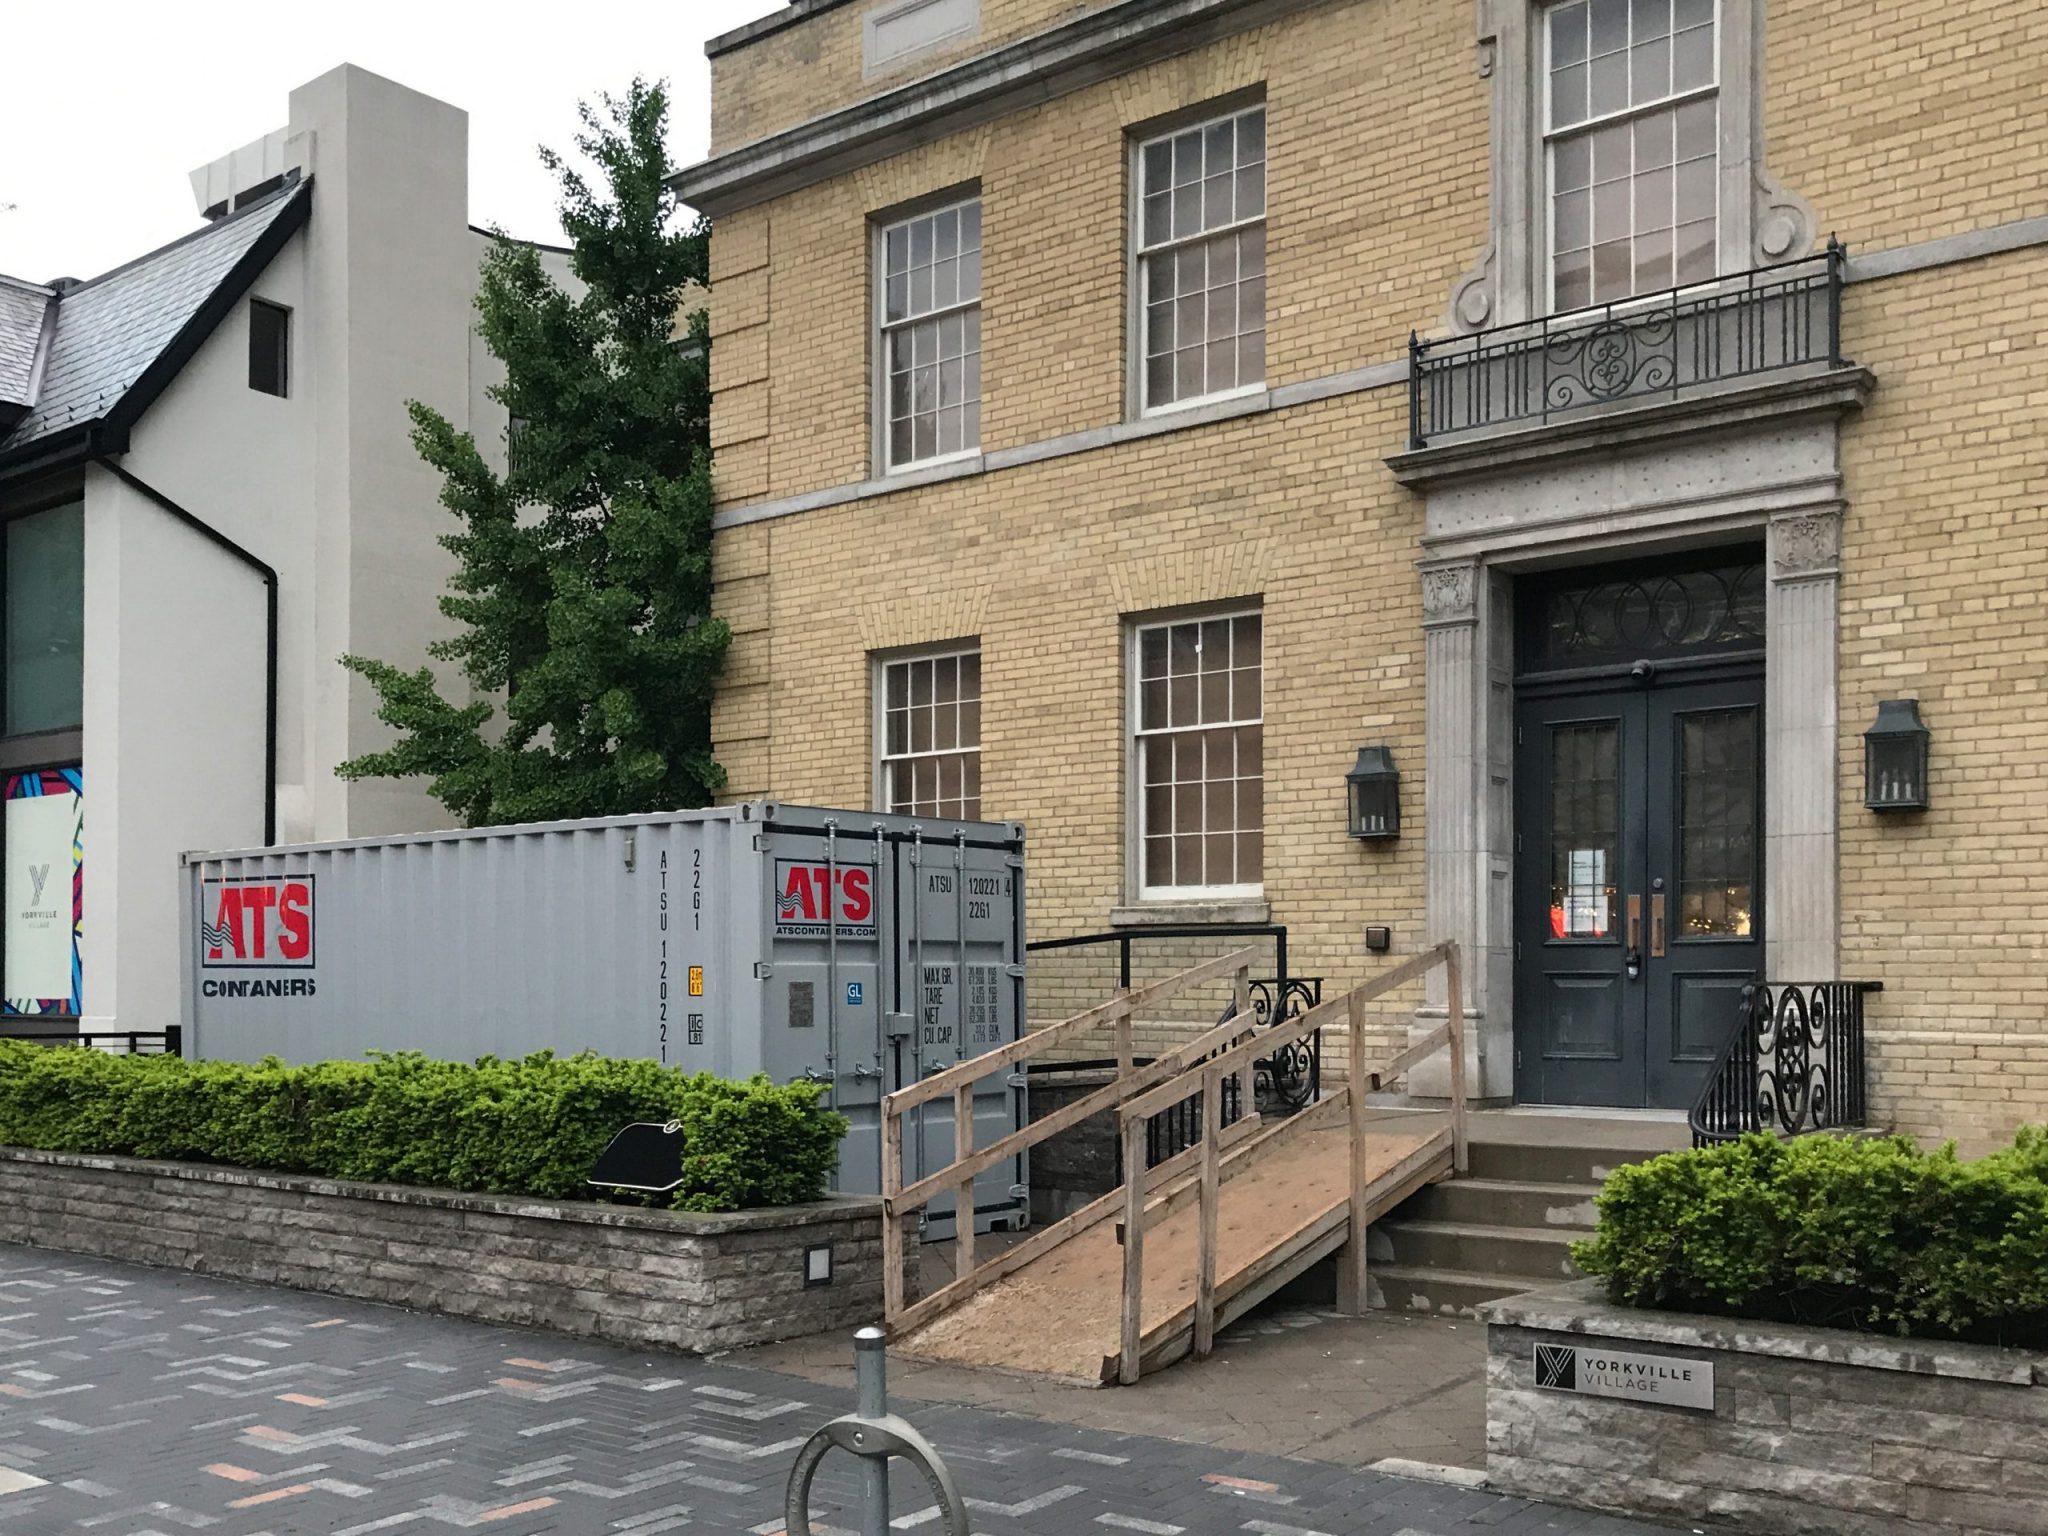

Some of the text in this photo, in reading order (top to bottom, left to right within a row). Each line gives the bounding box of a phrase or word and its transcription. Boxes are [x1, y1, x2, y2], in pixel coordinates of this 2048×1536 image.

[660, 850, 668, 931] ATSU
[693, 848, 701, 931] 22G1
[781, 866, 871, 922] ATS
[928, 874, 952, 893] ATSU
[968, 877, 1000, 895] 120221
[968, 901, 990, 919] 22G1
[208, 883, 310, 960] ATS
[776, 926, 876, 937] ATSCONTAIERS.COM
[847, 983, 862, 998] GL
[924, 986, 943, 1005] TARE
[924, 1006, 939, 1025] NET
[1584, 1358, 1692, 1381] YORKVILLE
[1585, 1374, 1660, 1393] VILLAGE
